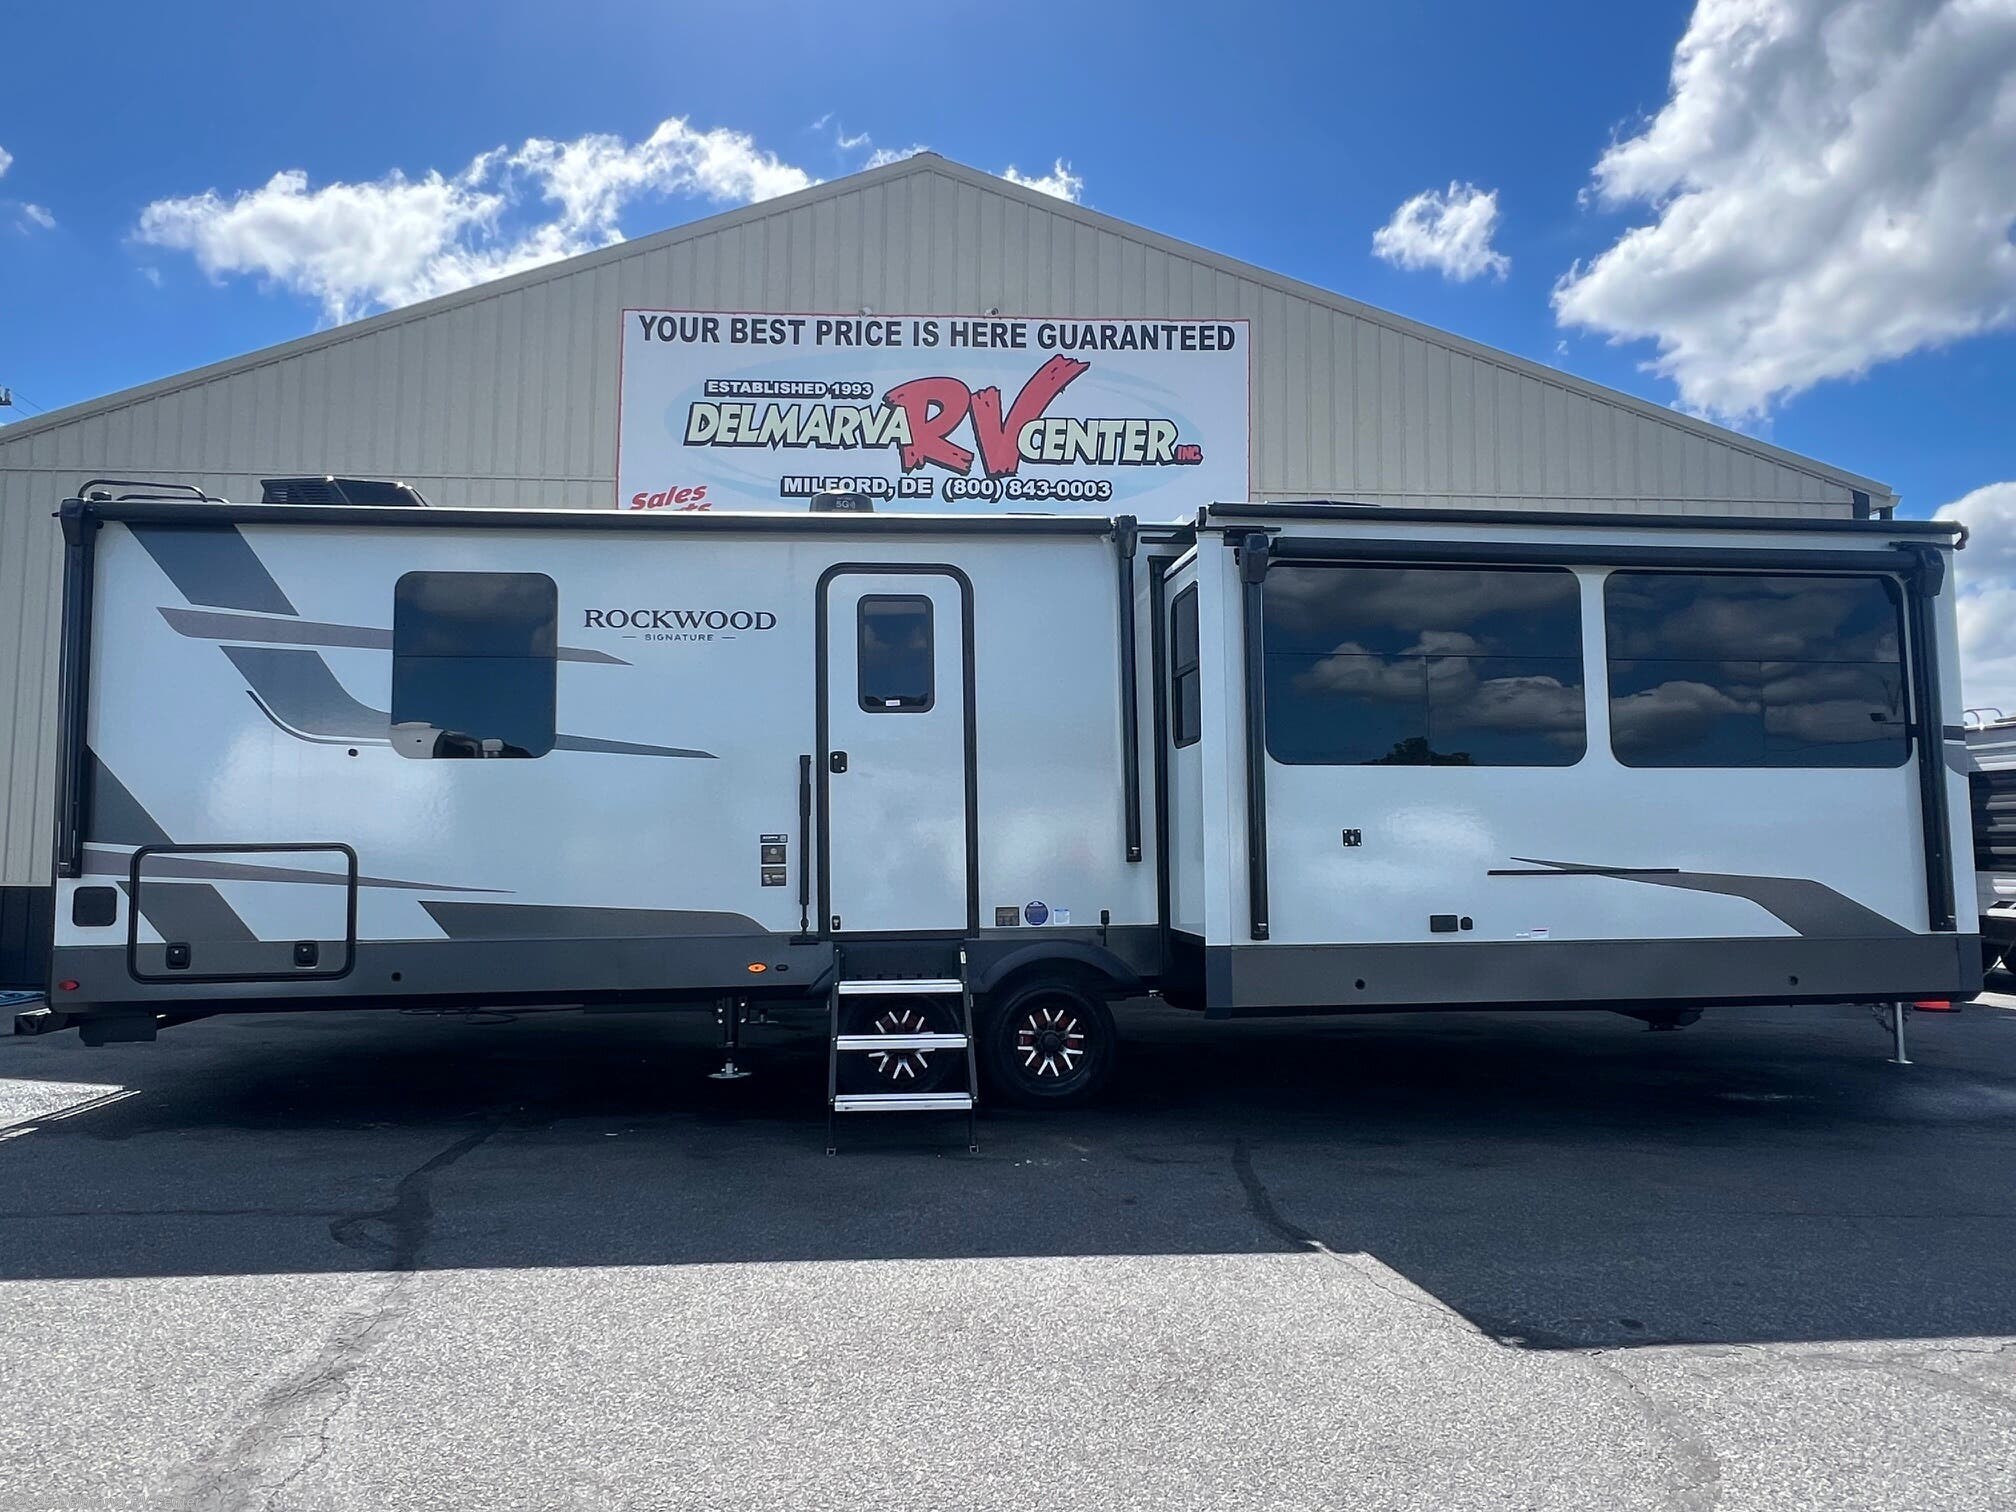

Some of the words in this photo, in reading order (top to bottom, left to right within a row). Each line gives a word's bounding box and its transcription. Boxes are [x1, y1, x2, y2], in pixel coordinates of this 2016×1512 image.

[639, 315, 720, 343] YOUR
[730, 319, 805, 345] BEST
[816, 320, 901, 347] PRICE
[913, 321, 940, 347] IS
[950, 321, 1027, 348] HERE
[1037, 324, 1235, 351] GUARANTEED
[707, 380, 827, 395] ESTABLISHED
[831, 382, 873, 397] 1993
[686, 402, 912, 449] DELMARVA
[882, 354, 1090, 479] RV
[1018, 418, 1178, 463] CENTER
[783, 477, 894, 497] MILFORD,
[901, 478, 932, 495] DE
[945, 479, 1003, 502] (800)
[1009, 480, 1112, 499] 843-0003
[835, 500, 850, 508] 5G
[584, 609, 777, 630] ROCKWOOD
[644, 633, 714, 642] SIGNATURE
